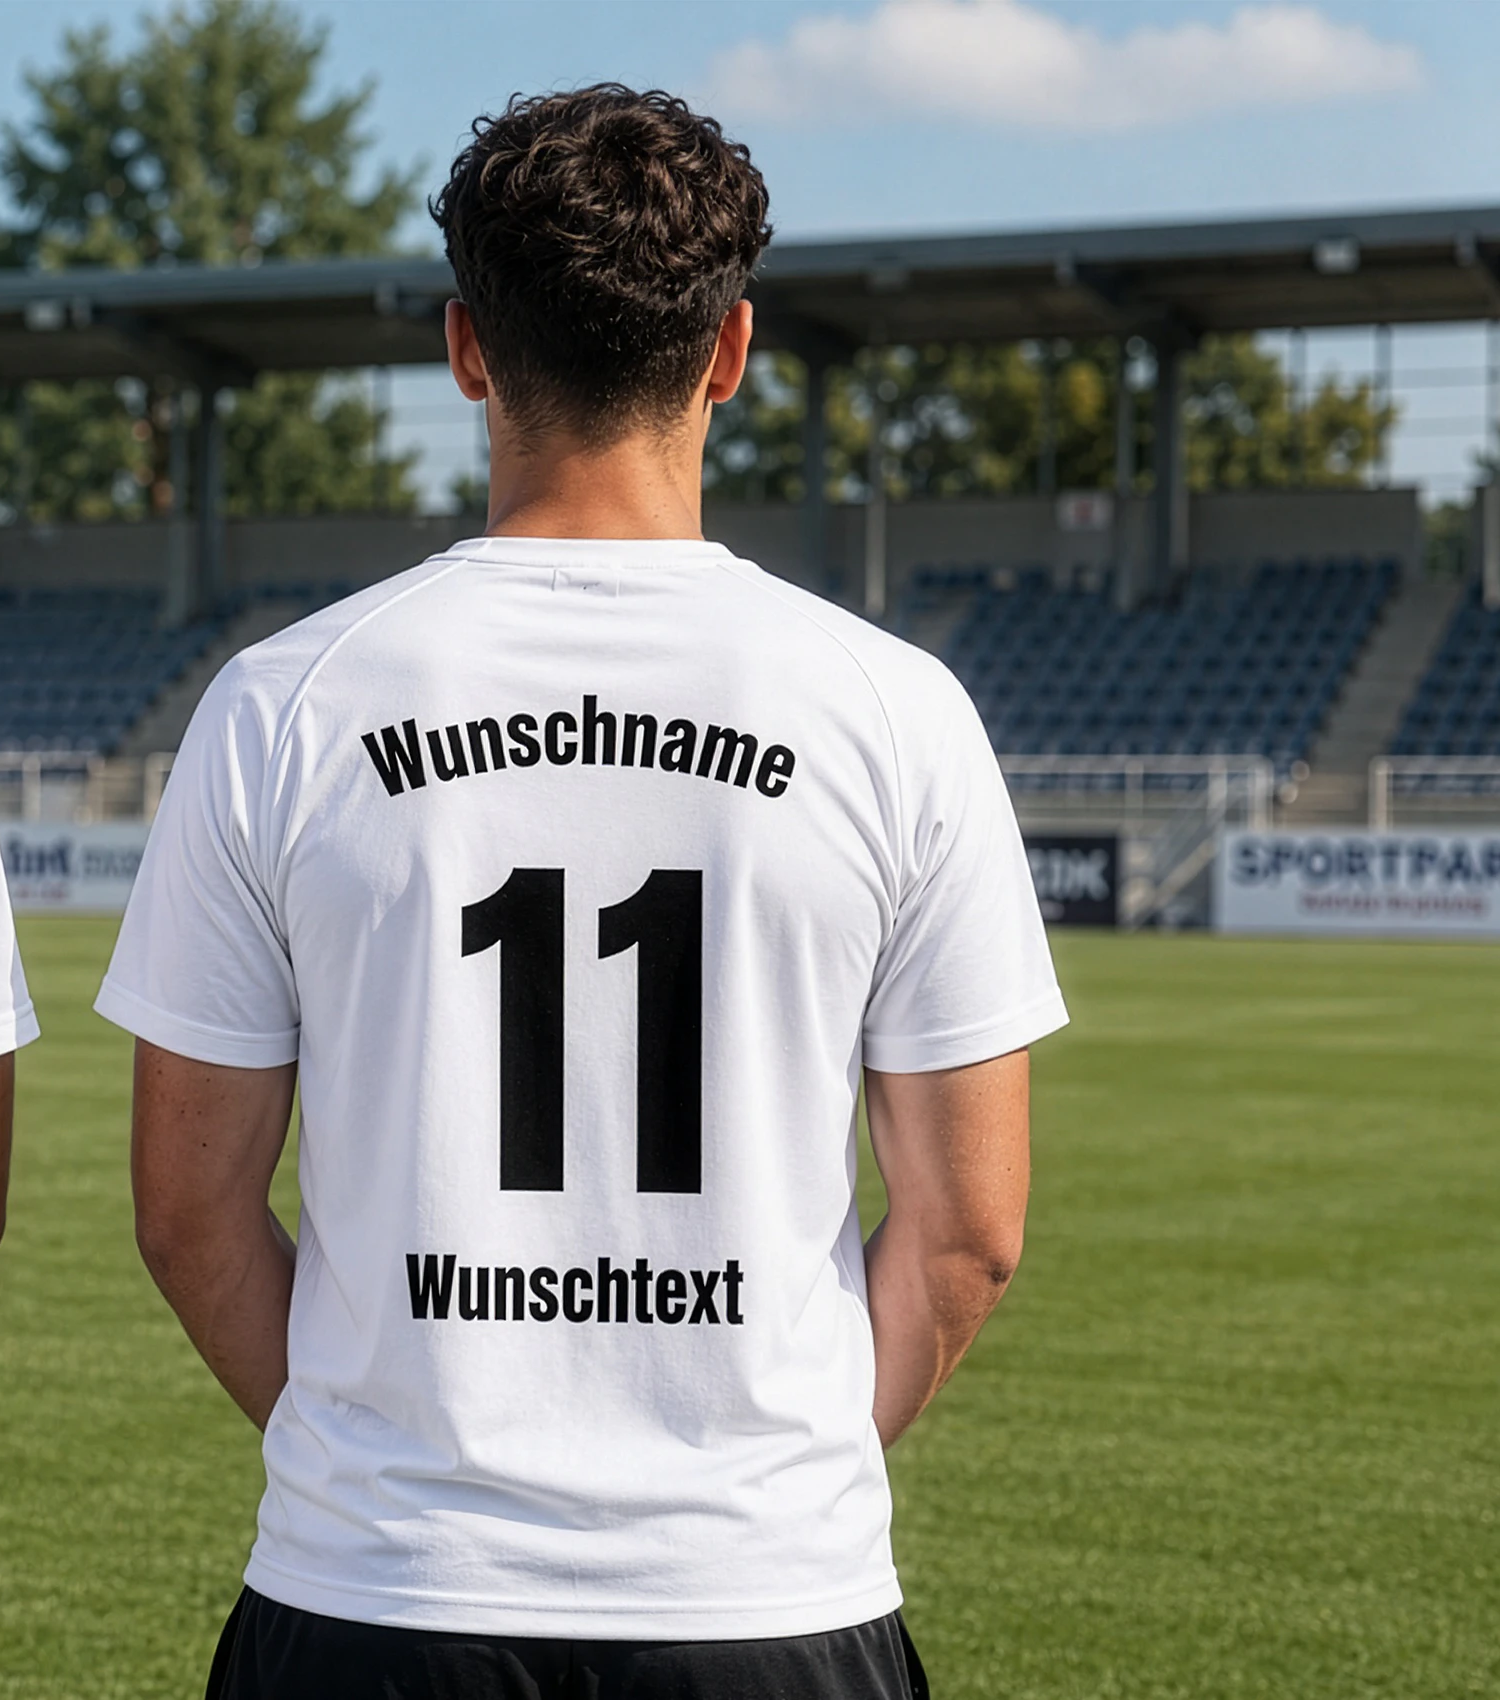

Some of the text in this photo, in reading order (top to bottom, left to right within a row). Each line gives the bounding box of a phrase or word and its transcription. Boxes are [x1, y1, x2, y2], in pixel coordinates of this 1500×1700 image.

[360, 694, 795, 798] Wunschname
[460, 867, 704, 1194] 11
[405, 1252, 744, 1325] Wunschtext
